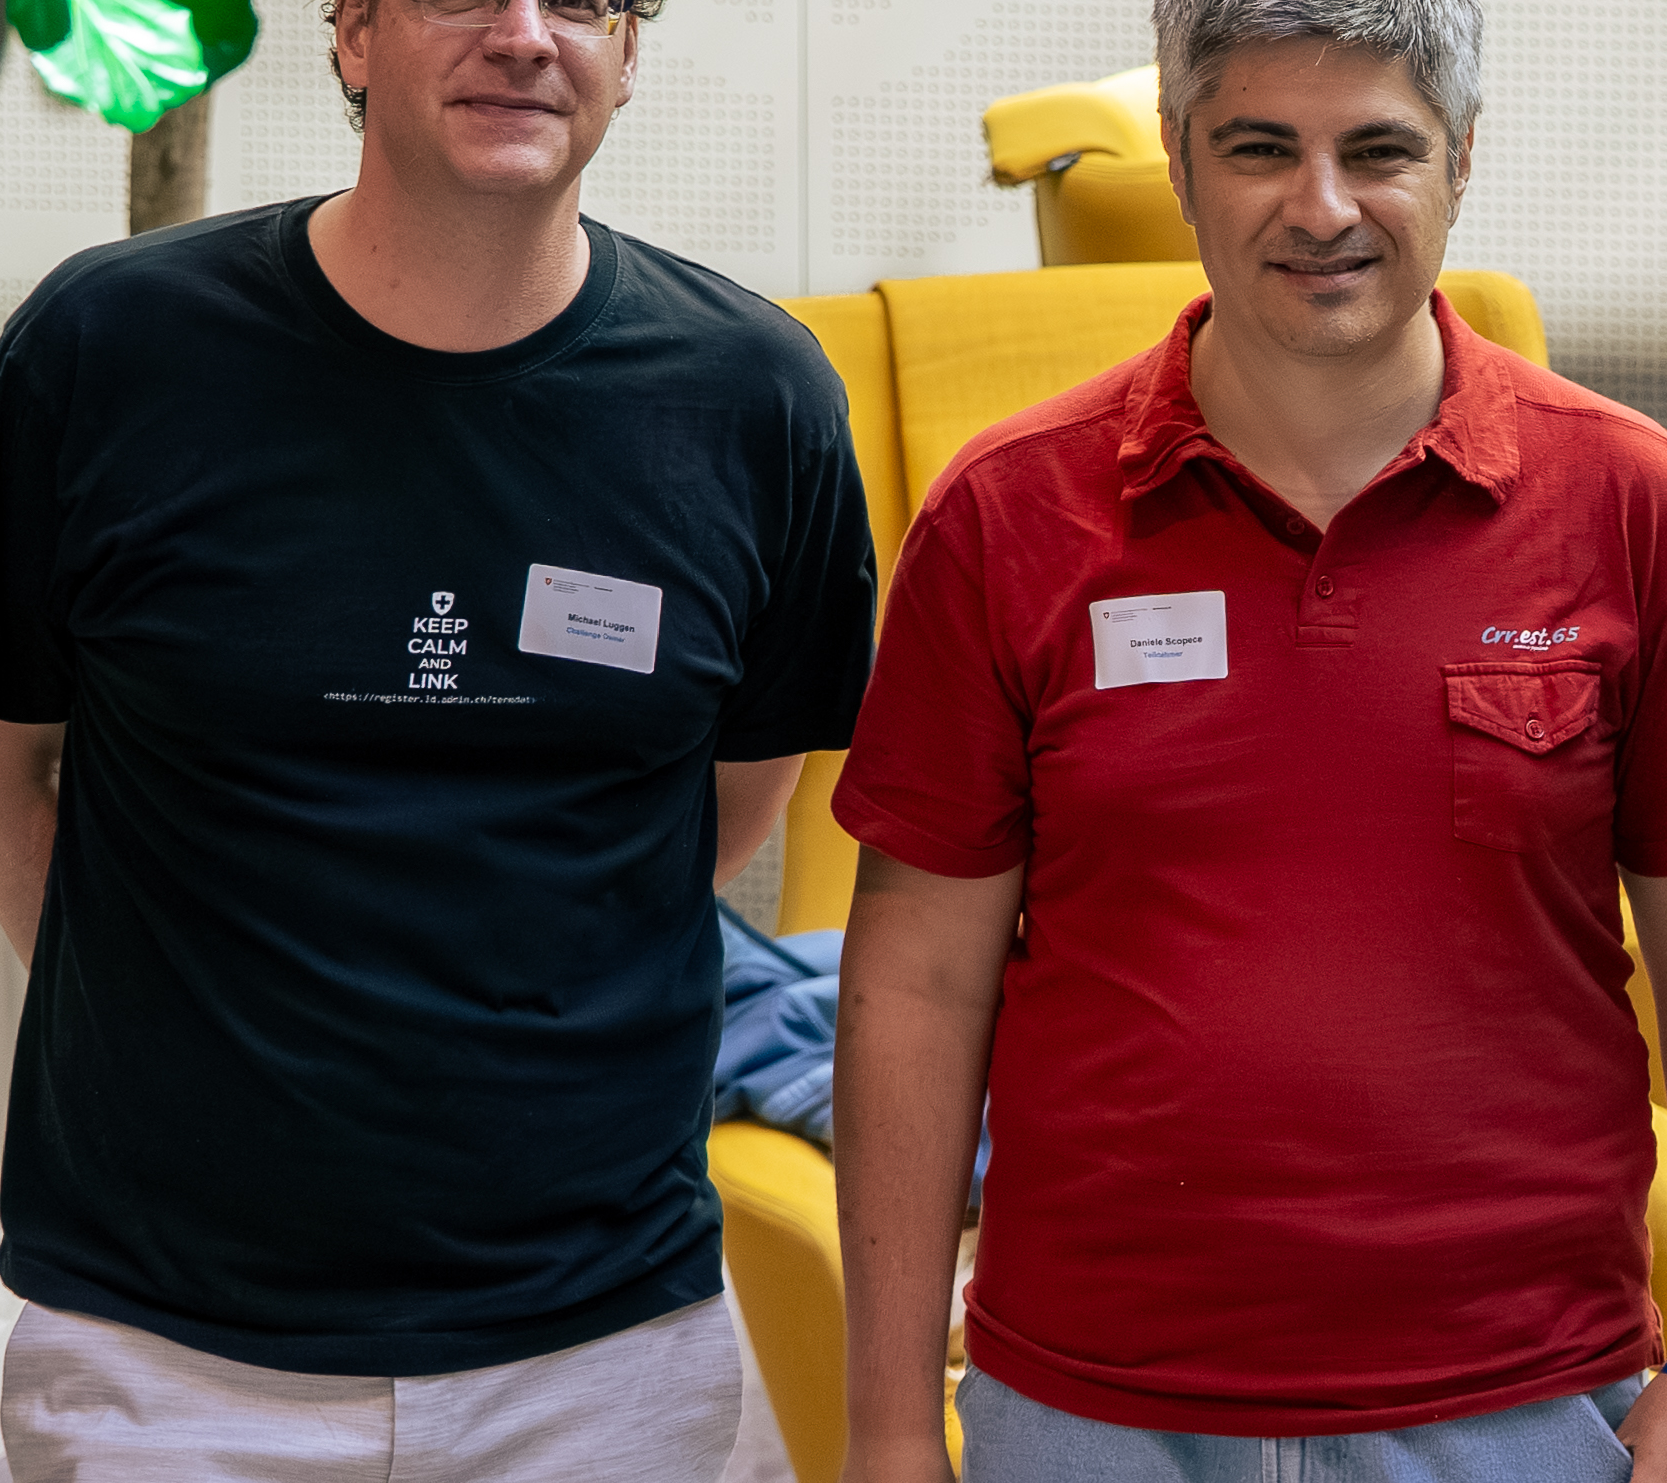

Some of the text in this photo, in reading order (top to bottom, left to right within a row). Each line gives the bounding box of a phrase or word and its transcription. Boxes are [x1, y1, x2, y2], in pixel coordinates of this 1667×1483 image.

[413, 617, 469, 634] KEEP
[567, 613, 635, 633] Michael Luggen
[407, 638, 468, 655] CALM
[1130, 636, 1203, 648] Daniele Scopece
[418, 658, 452, 670] AND
[408, 673, 459, 690] LINK
